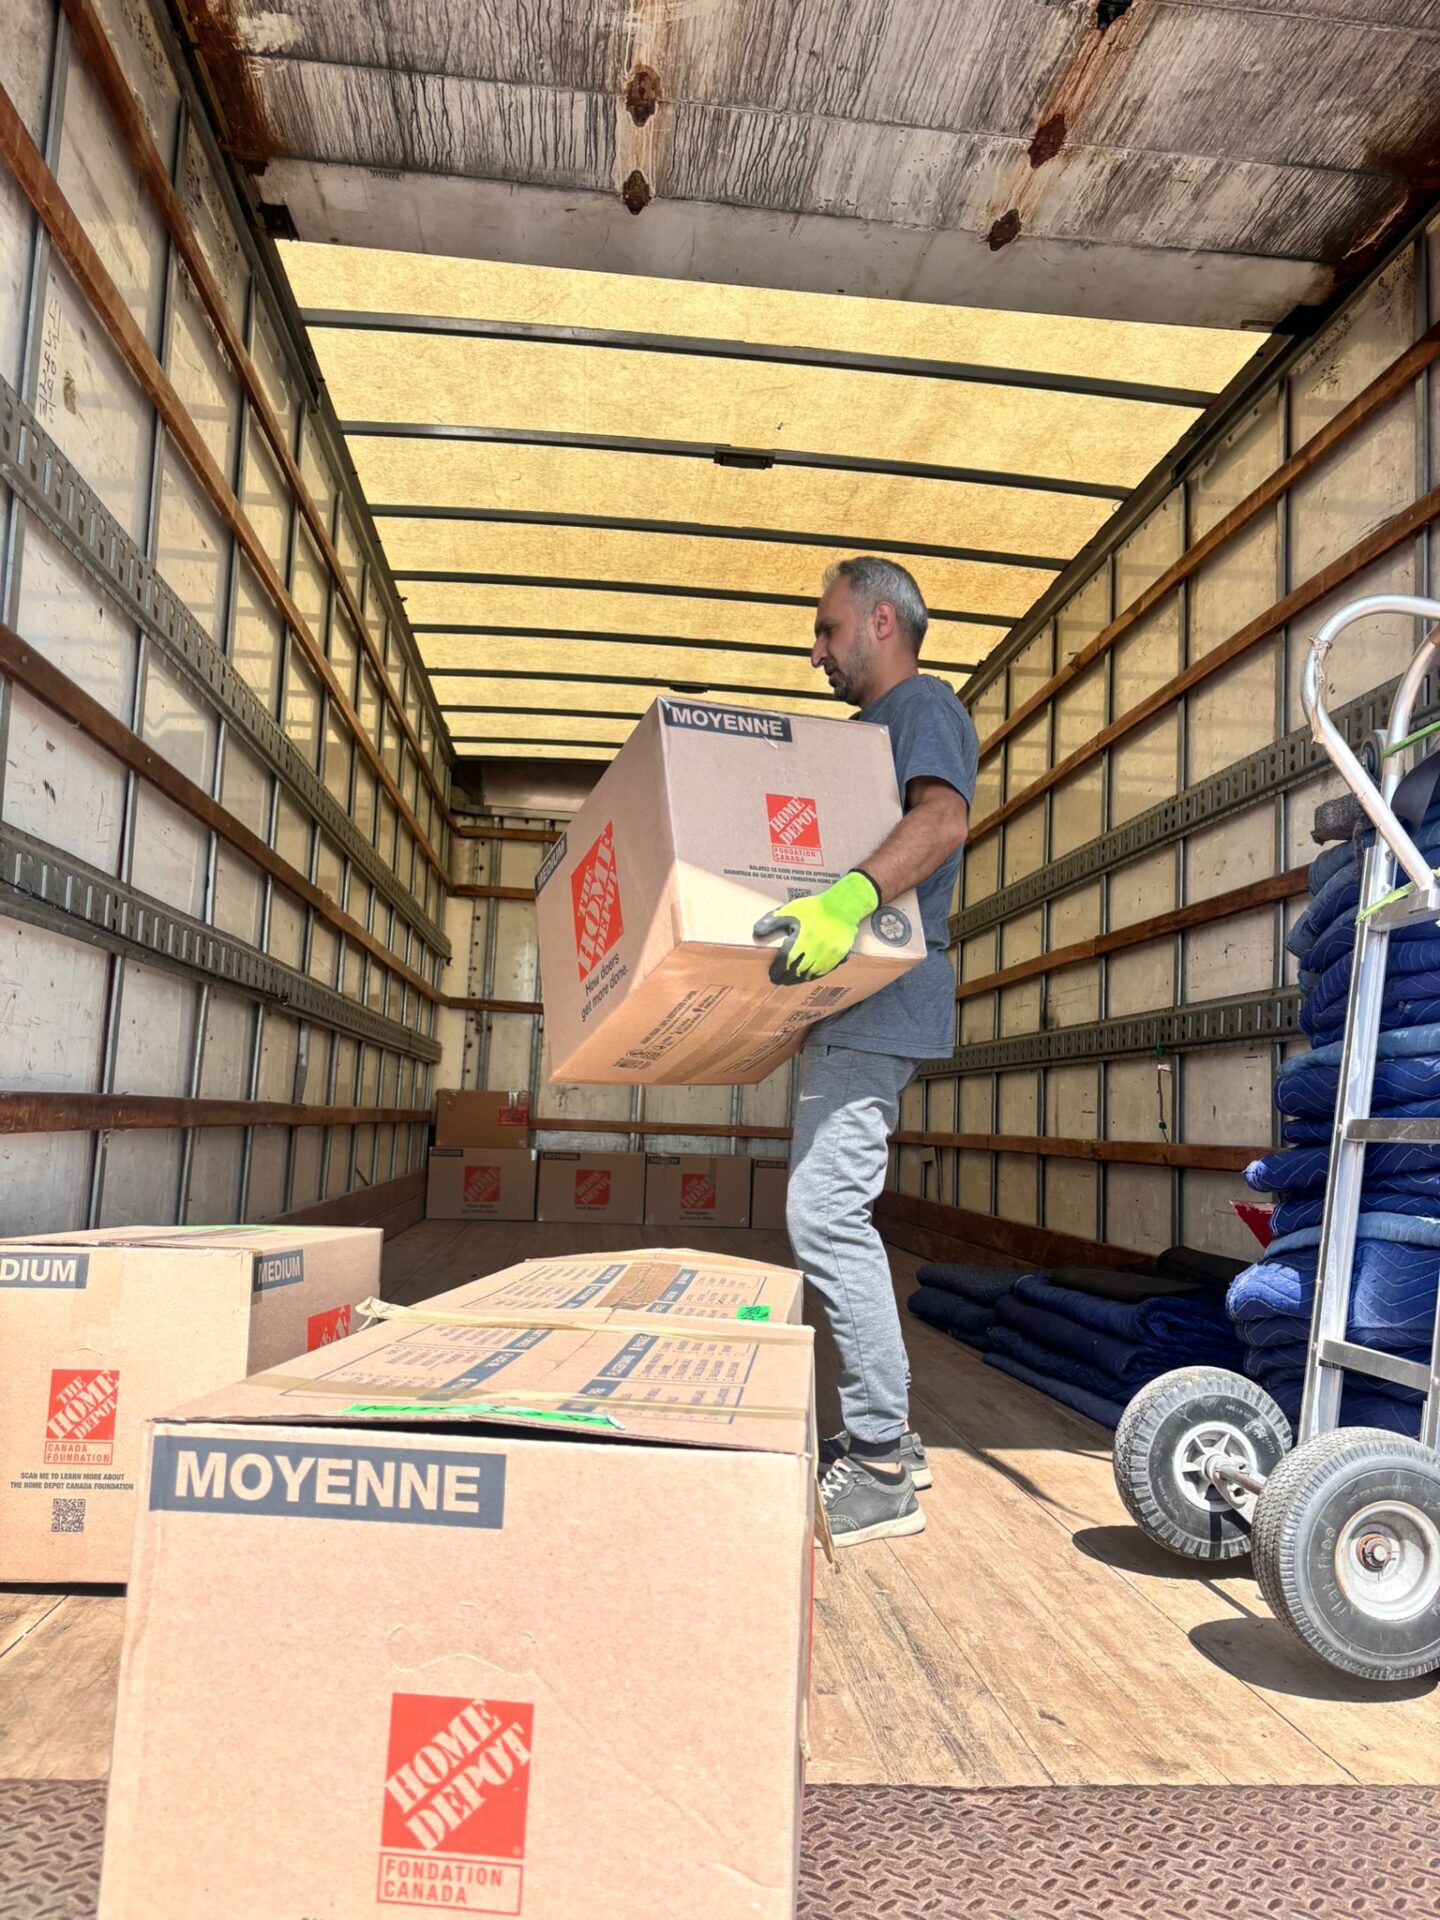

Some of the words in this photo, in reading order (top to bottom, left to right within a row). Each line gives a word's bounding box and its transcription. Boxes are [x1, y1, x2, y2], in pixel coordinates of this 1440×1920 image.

[671, 706, 784, 737] MOYENNE
[769, 797, 804, 833] HOME
[779, 805, 818, 845] DEPOT
[537, 840, 565, 890] MEDIUM
[774, 847, 816, 857] FONDATION
[775, 853, 805, 862] CANADA
[578, 832, 613, 972] HOME
[585, 972, 600, 997] How
[600, 953, 620, 981] doers
[581, 1000, 593, 1023] get
[592, 983, 609, 1009] more
[258, 1257, 300, 1284] MEDIUM
[48, 1370, 119, 1439] HOME
[56, 1376, 87, 1404] THE
[73, 1395, 117, 1439] DEPOT
[47, 1453, 110, 1463] FOUNDATION
[48, 1443, 87, 1453] CANADA
[60, 1472, 82, 1480] LEARN
[174, 1449, 481, 1513] MOYENNE
[385, 1699, 502, 1814] HOME
[405, 1721, 531, 1851] DEPOT
[386, 1859, 503, 1887] FONDATION
[384, 1880, 467, 1904] CANADA
